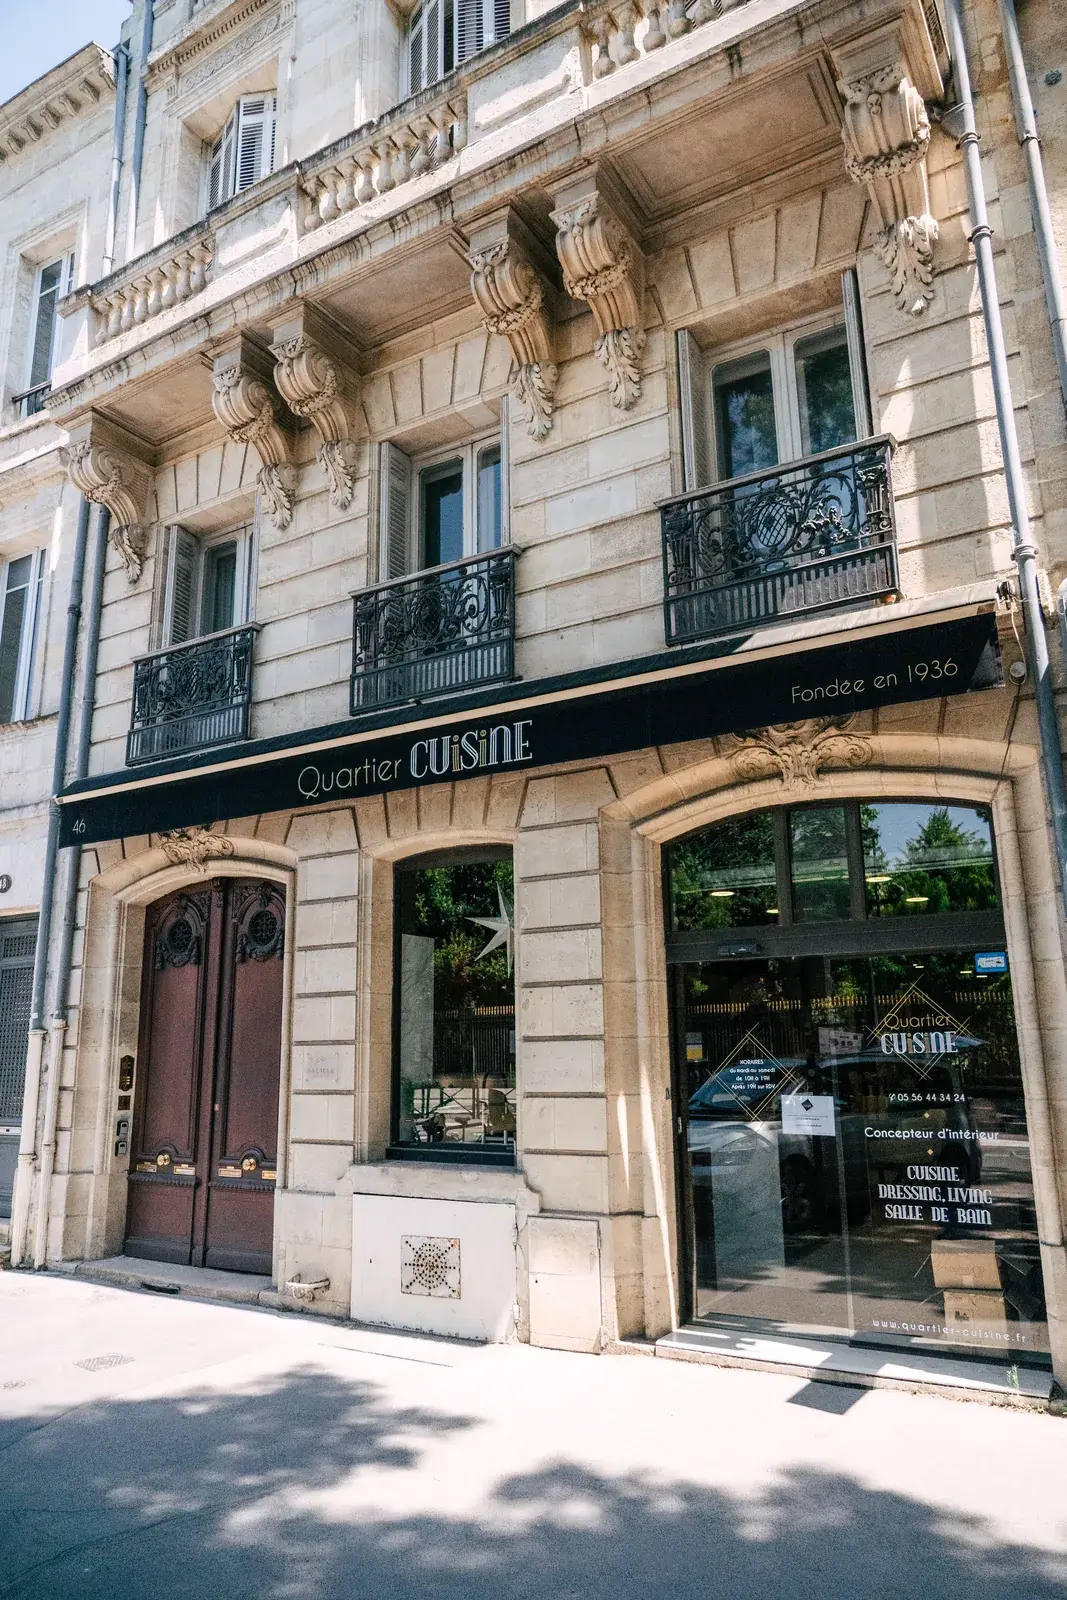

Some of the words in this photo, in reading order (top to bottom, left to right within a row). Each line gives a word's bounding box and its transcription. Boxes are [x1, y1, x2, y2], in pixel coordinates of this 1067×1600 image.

[792, 678, 866, 704] Fondée
[873, 673, 898, 689] en
[907, 657, 958, 683] 1936
[297, 758, 402, 799] Quartier
[72, 818, 86, 835] 46
[884, 1013, 951, 1030] Quartier
[897, 1093, 909, 1101] 05
[911, 1093, 923, 1101] 56
[925, 1093, 937, 1102] 44
[940, 1093, 951, 1102] 34
[953, 1093, 966, 1102] 24
[864, 1126, 933, 1140] Concepteur
[937, 1128, 999, 1140] d'intérieur
[948, 1187, 993, 1205] LIVING
[885, 1203, 924, 1221] SALLE
[931, 1206, 950, 1223] DE
[957, 1208, 992, 1226] BAIN
[872, 1318, 1026, 1343] www.quartier-cuisine.fr
